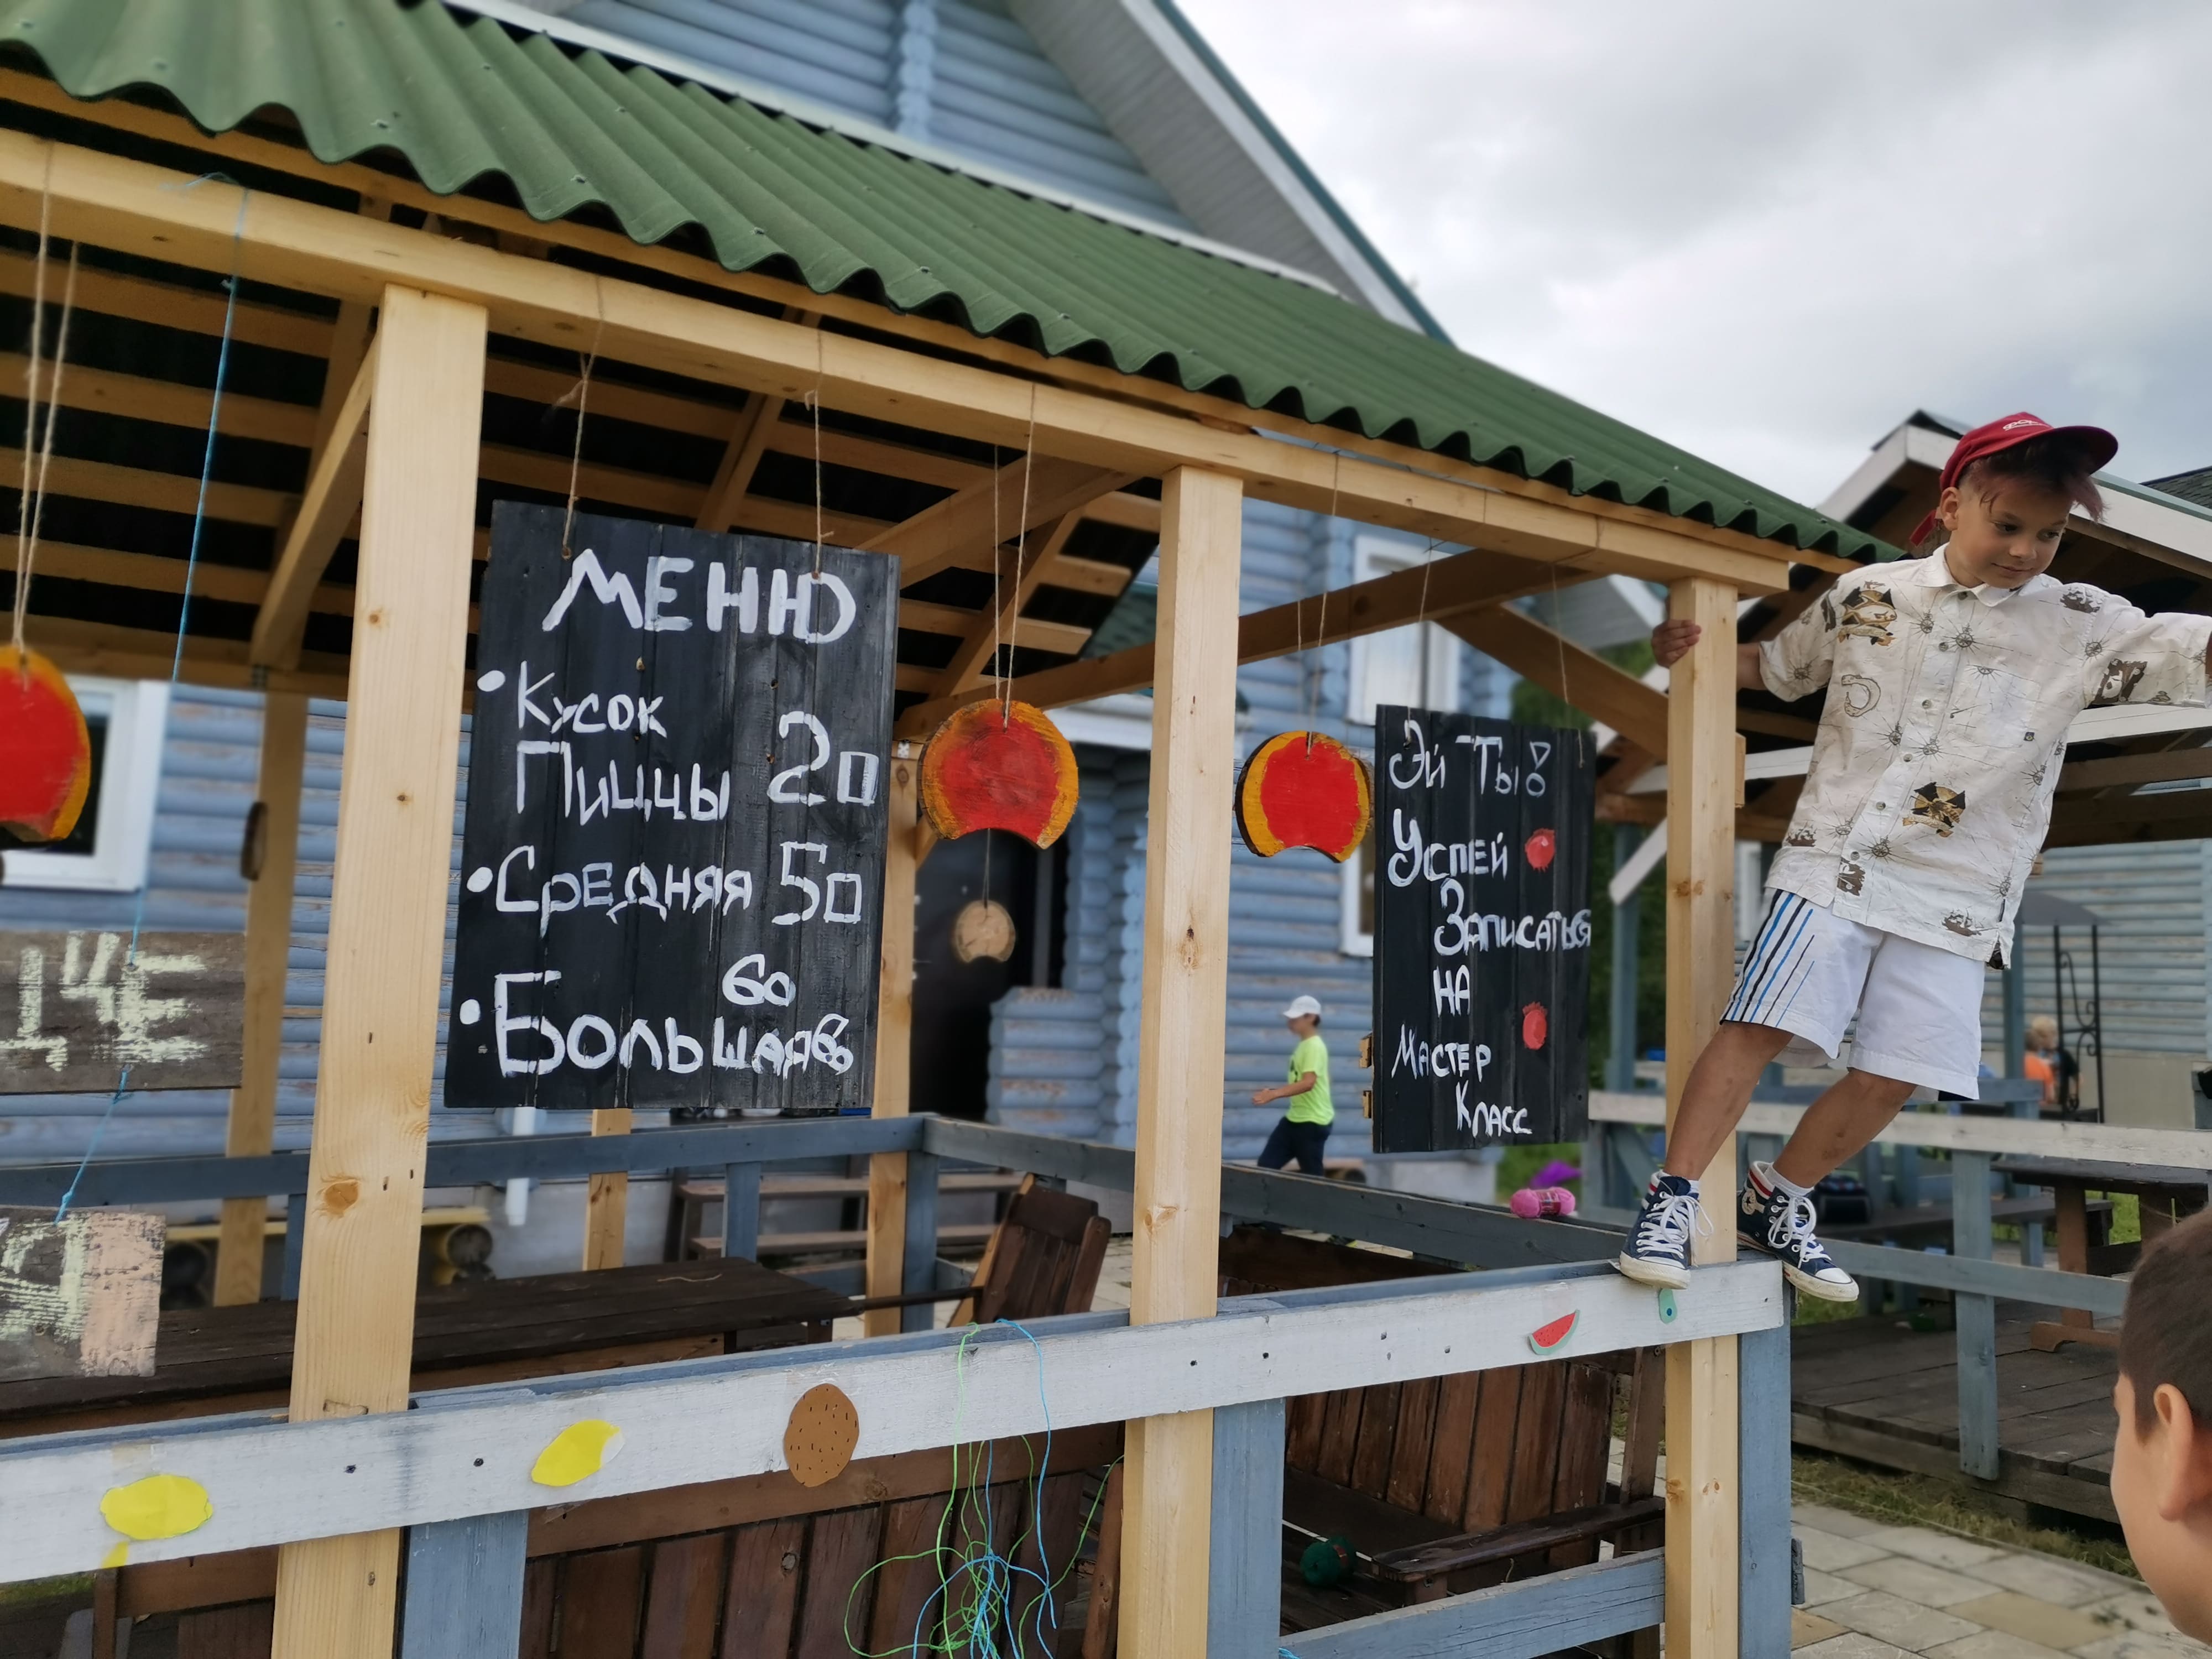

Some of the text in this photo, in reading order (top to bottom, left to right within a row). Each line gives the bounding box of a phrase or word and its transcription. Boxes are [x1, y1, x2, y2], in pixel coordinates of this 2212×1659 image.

[541, 549, 856, 644] МЕНЮ
[766, 710, 879, 806] 20
[771, 841, 862, 924] 50
[722, 953, 795, 1006] 60
[1433, 964, 1470, 1017] НА
